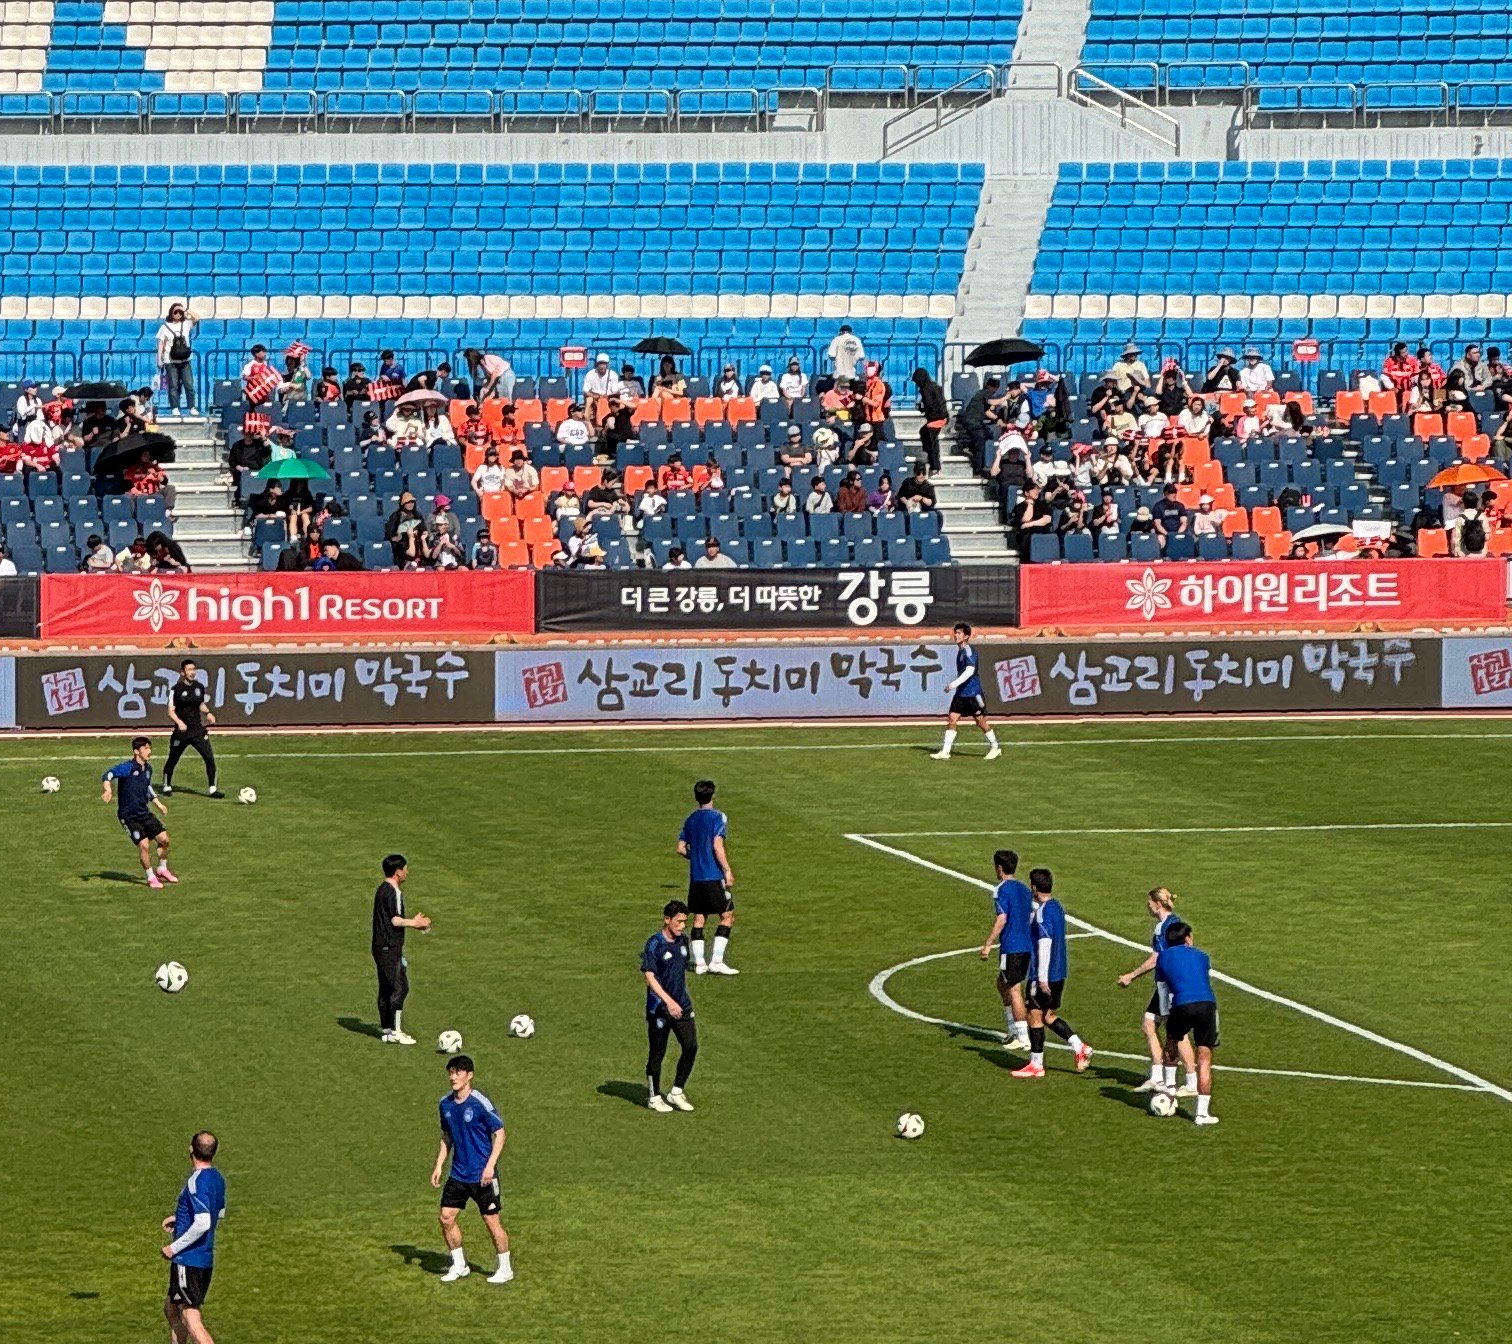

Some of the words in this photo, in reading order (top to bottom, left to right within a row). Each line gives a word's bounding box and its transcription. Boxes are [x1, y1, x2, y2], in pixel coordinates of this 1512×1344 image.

[189, 585, 311, 631] high1
[621, 585, 643, 613] 더
[648, 586, 671, 612] 큰
[729, 584, 750, 612] 더
[756, 584, 822, 612] 따뜻한
[838, 570, 934, 626] 강릉
